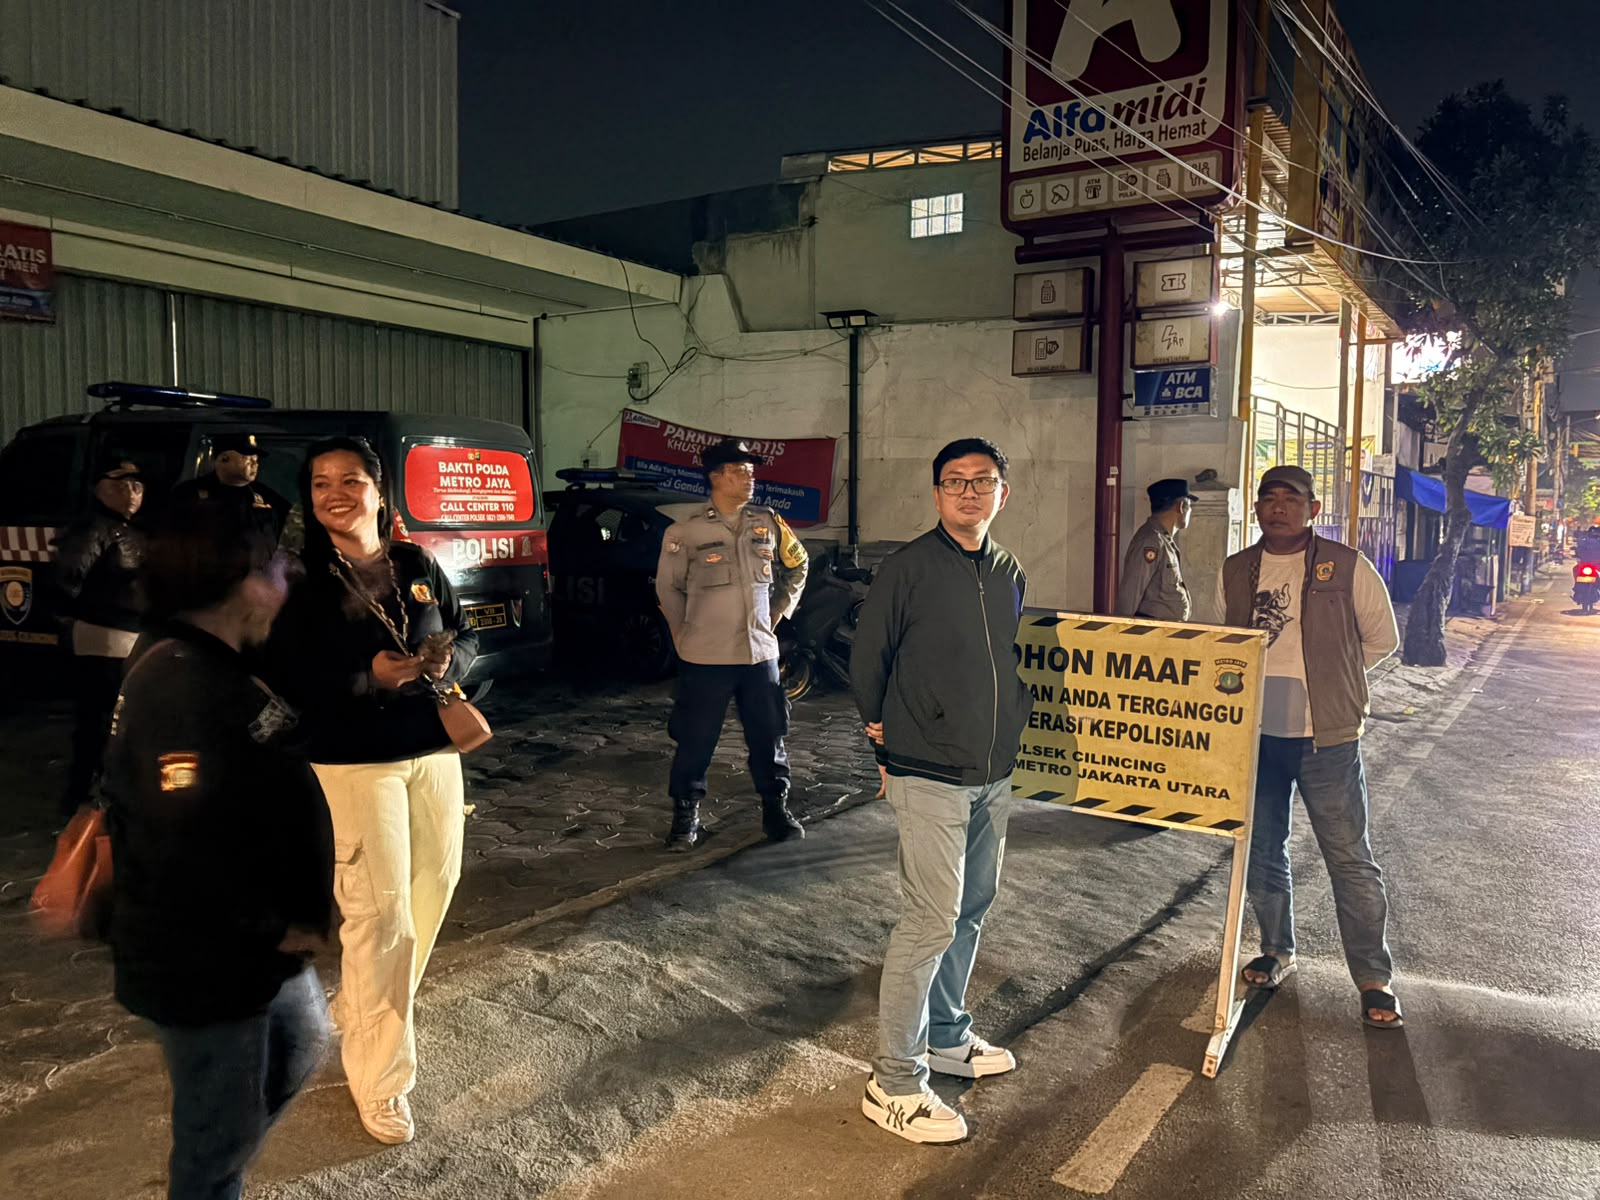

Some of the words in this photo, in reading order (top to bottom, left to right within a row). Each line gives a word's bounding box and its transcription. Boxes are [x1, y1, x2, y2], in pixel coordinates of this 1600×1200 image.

[1023, 77, 1208, 144] Alfamidi
[1023, 142, 1070, 162] Belanja
[1074, 135, 1110, 153] Puas,
[1114, 129, 1154, 149] Harga
[1158, 118, 1207, 142] Hemat
[1086, 178, 1101, 186] ATM
[0, 243, 47, 264] ATIS
[1165, 371, 1197, 385] ATM
[1174, 385, 1203, 399] BCA
[438, 462, 473, 474] BAKTI
[476, 463, 509, 476] POLDA
[439, 476, 482, 488] METRO
[485, 477, 511, 489] JAYA
[674, 479, 705, 494] Ganda
[766, 484, 805, 497] Terimakasih
[439, 502, 464, 512] CALL
[466, 503, 499, 512] CENTER
[501, 503, 514, 512] 110
[764, 496, 792, 510] Anda
[452, 537, 514, 561] POLISI
[1014, 642, 1094, 676] HON
[1105, 652, 1201, 686] MAAF
[1058, 687, 1111, 710] ANDA
[1117, 693, 1244, 725] TERGANGGU
[1028, 711, 1084, 735] ERASI
[1090, 718, 1211, 752] KEPOLISIAN
[1016, 744, 1066, 760] LSEK
[1072, 750, 1167, 774] CILINCING
[1013, 758, 1072, 777] METRO
[1077, 768, 1161, 791] JAKARTA
[1167, 780, 1231, 801] UTARA
